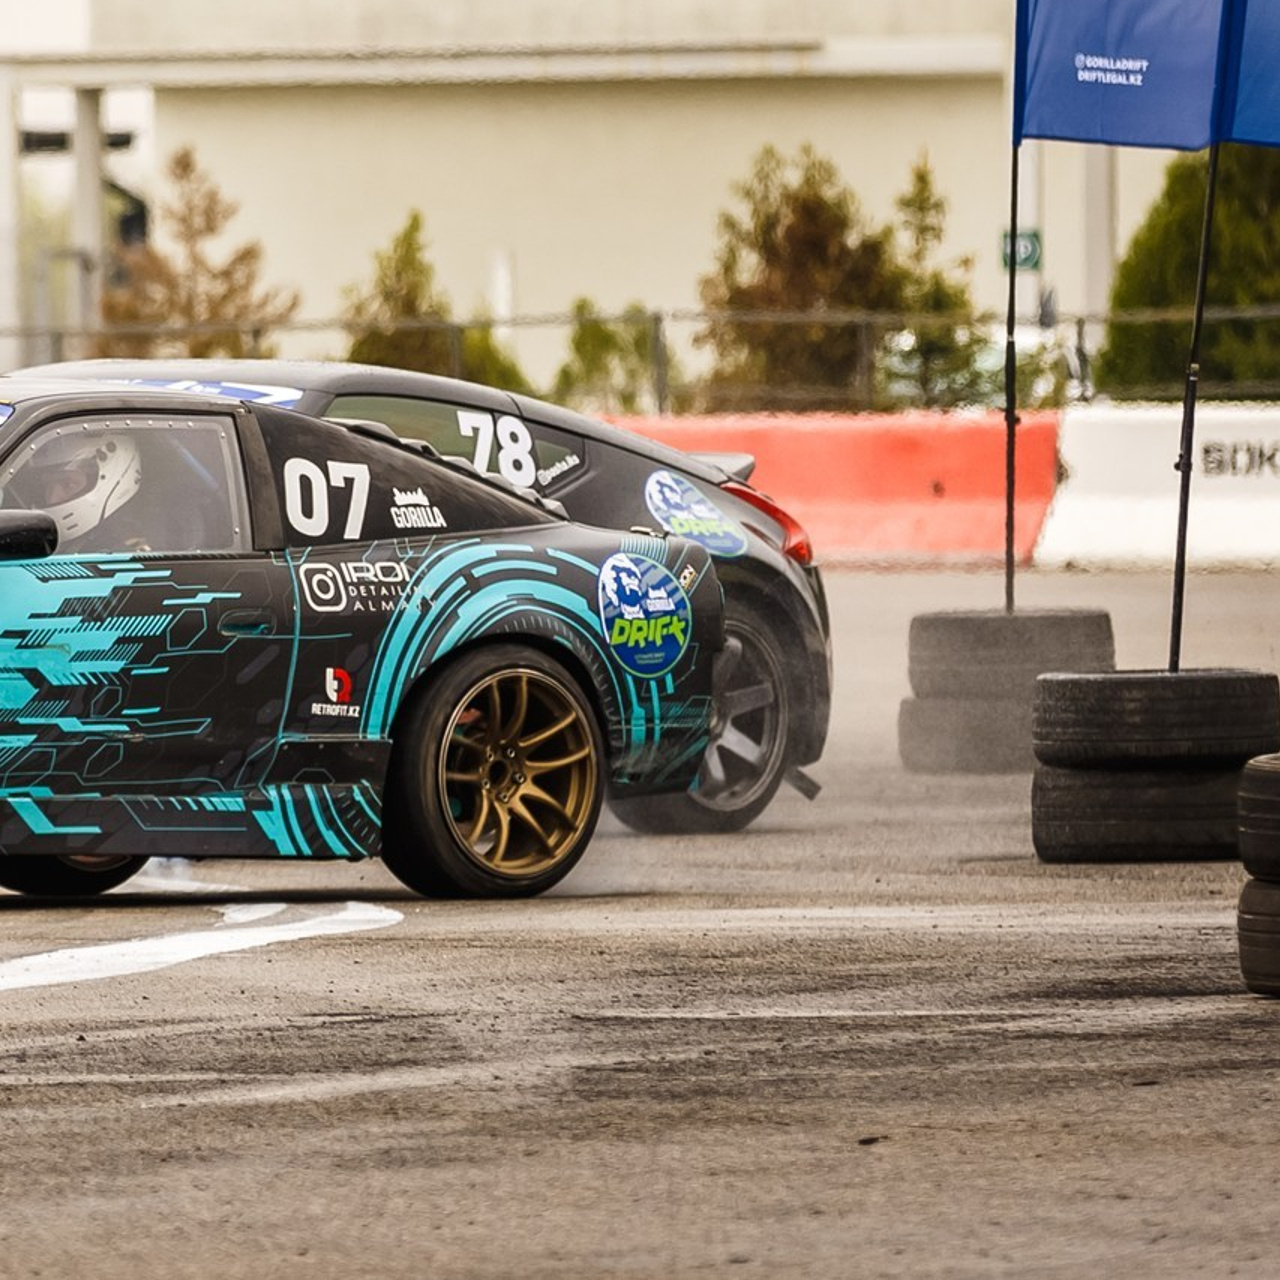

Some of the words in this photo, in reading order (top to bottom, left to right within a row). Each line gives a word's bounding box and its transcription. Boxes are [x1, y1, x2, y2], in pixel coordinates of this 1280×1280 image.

[457, 410, 536, 488] 78
[284, 457, 371, 540] 07
[390, 505, 447, 529] GORILLA
[610, 615, 686, 648] DRIFT
